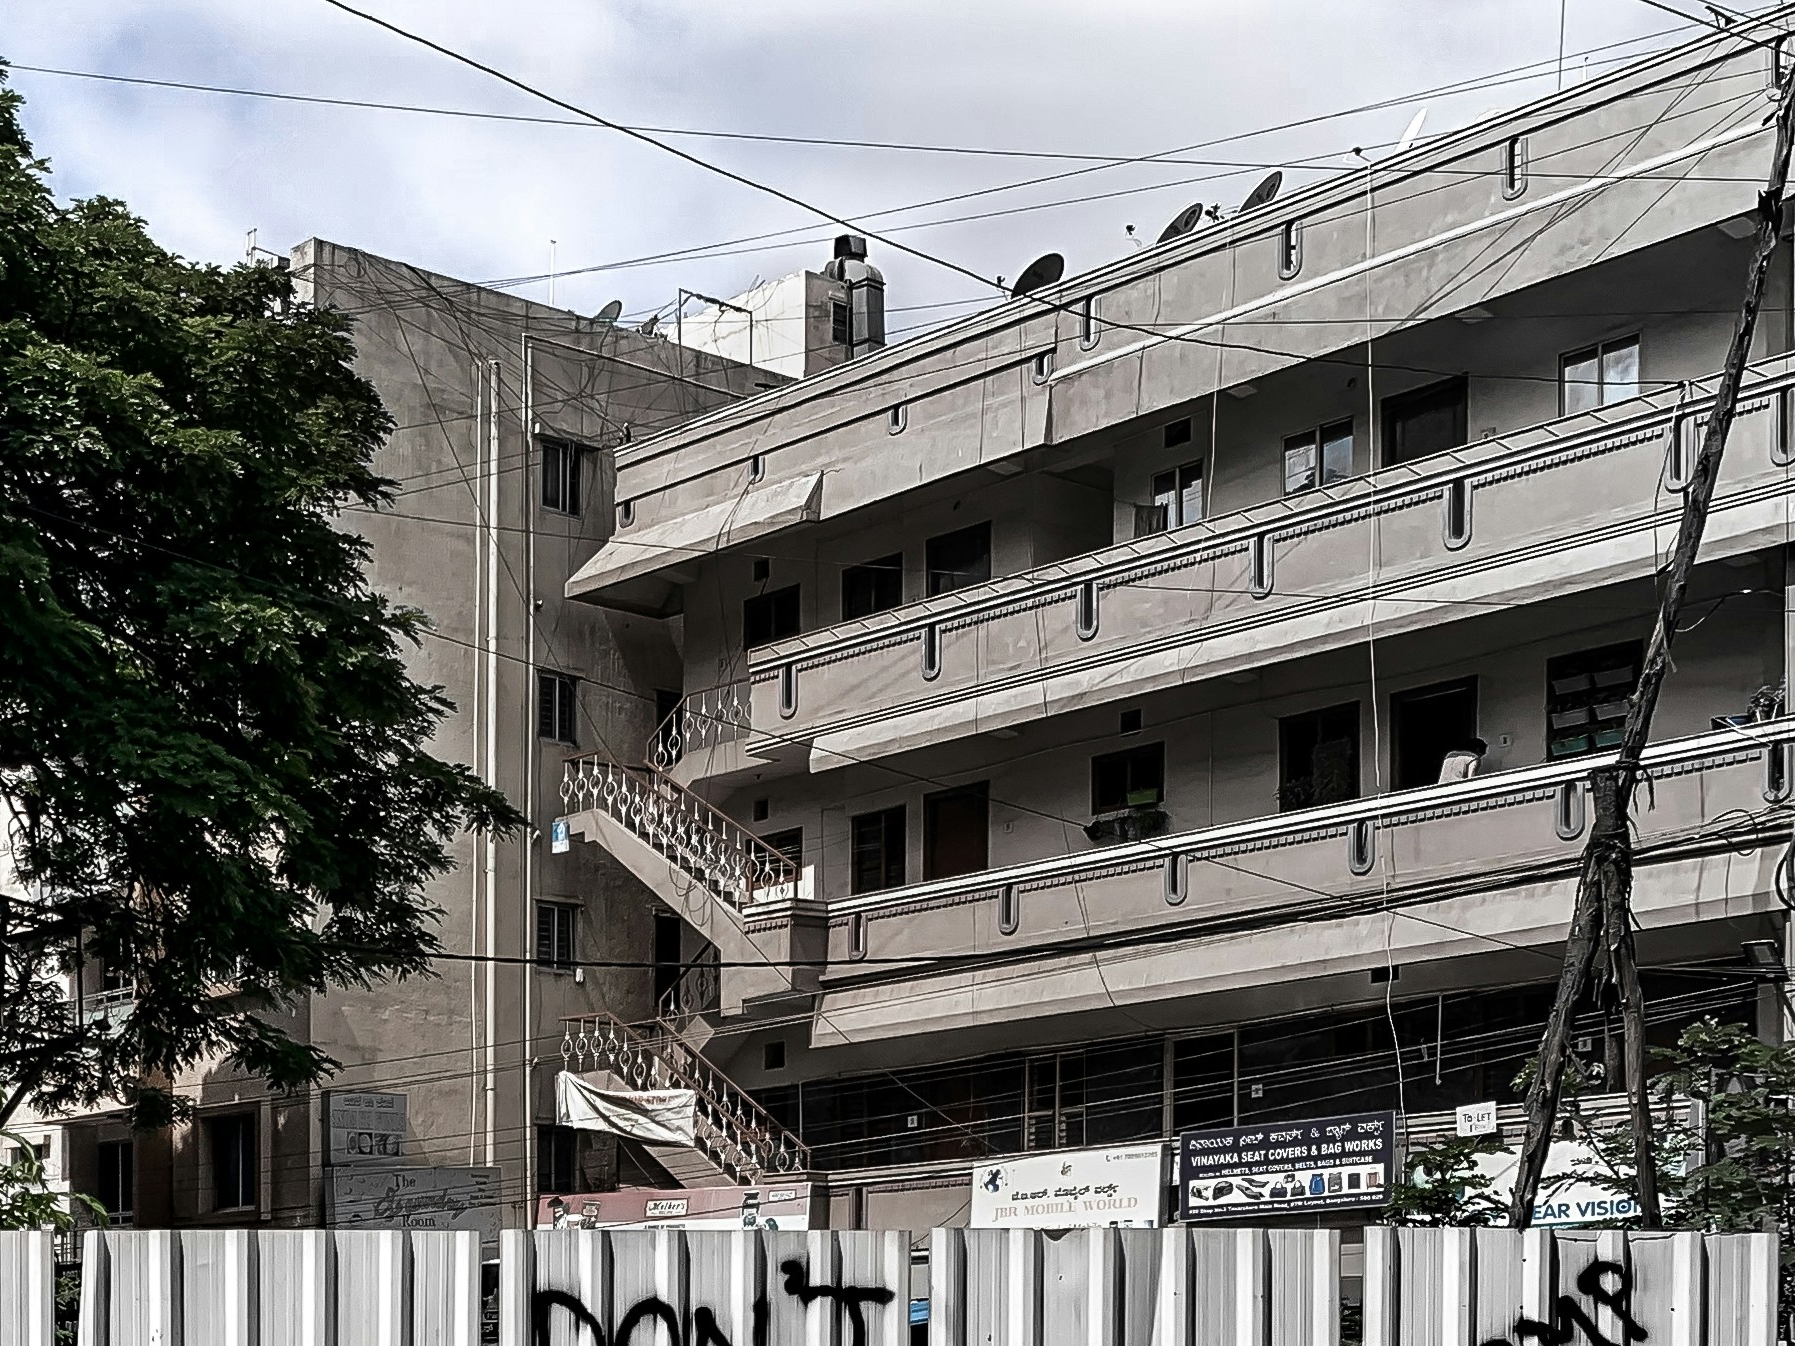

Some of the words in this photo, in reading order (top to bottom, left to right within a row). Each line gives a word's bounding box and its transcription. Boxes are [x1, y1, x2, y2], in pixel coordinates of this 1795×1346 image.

[1310, 1127, 1321, 1138] &
[1190, 1152, 1239, 1167] VINAYAKA
[1241, 1148, 1265, 1163] SEAT
[1268, 1145, 1308, 1160] COVERS
[1311, 1144, 1318, 1156] &
[1321, 1141, 1342, 1155] BAG
[1344, 1138, 1383, 1153] WORKS
[1252, 1165, 1267, 1173] SEAT
[1341, 1155, 1373, 1166] SUITCASE
[393, 1172, 416, 1188] The
[992, 1206, 1018, 1222] JBR
[1024, 1199, 1076, 1216] MOBILE
[1082, 1196, 1138, 1211] WORLD
[1533, 1203, 1570, 1220] EAR
[402, 1214, 436, 1228] Room
